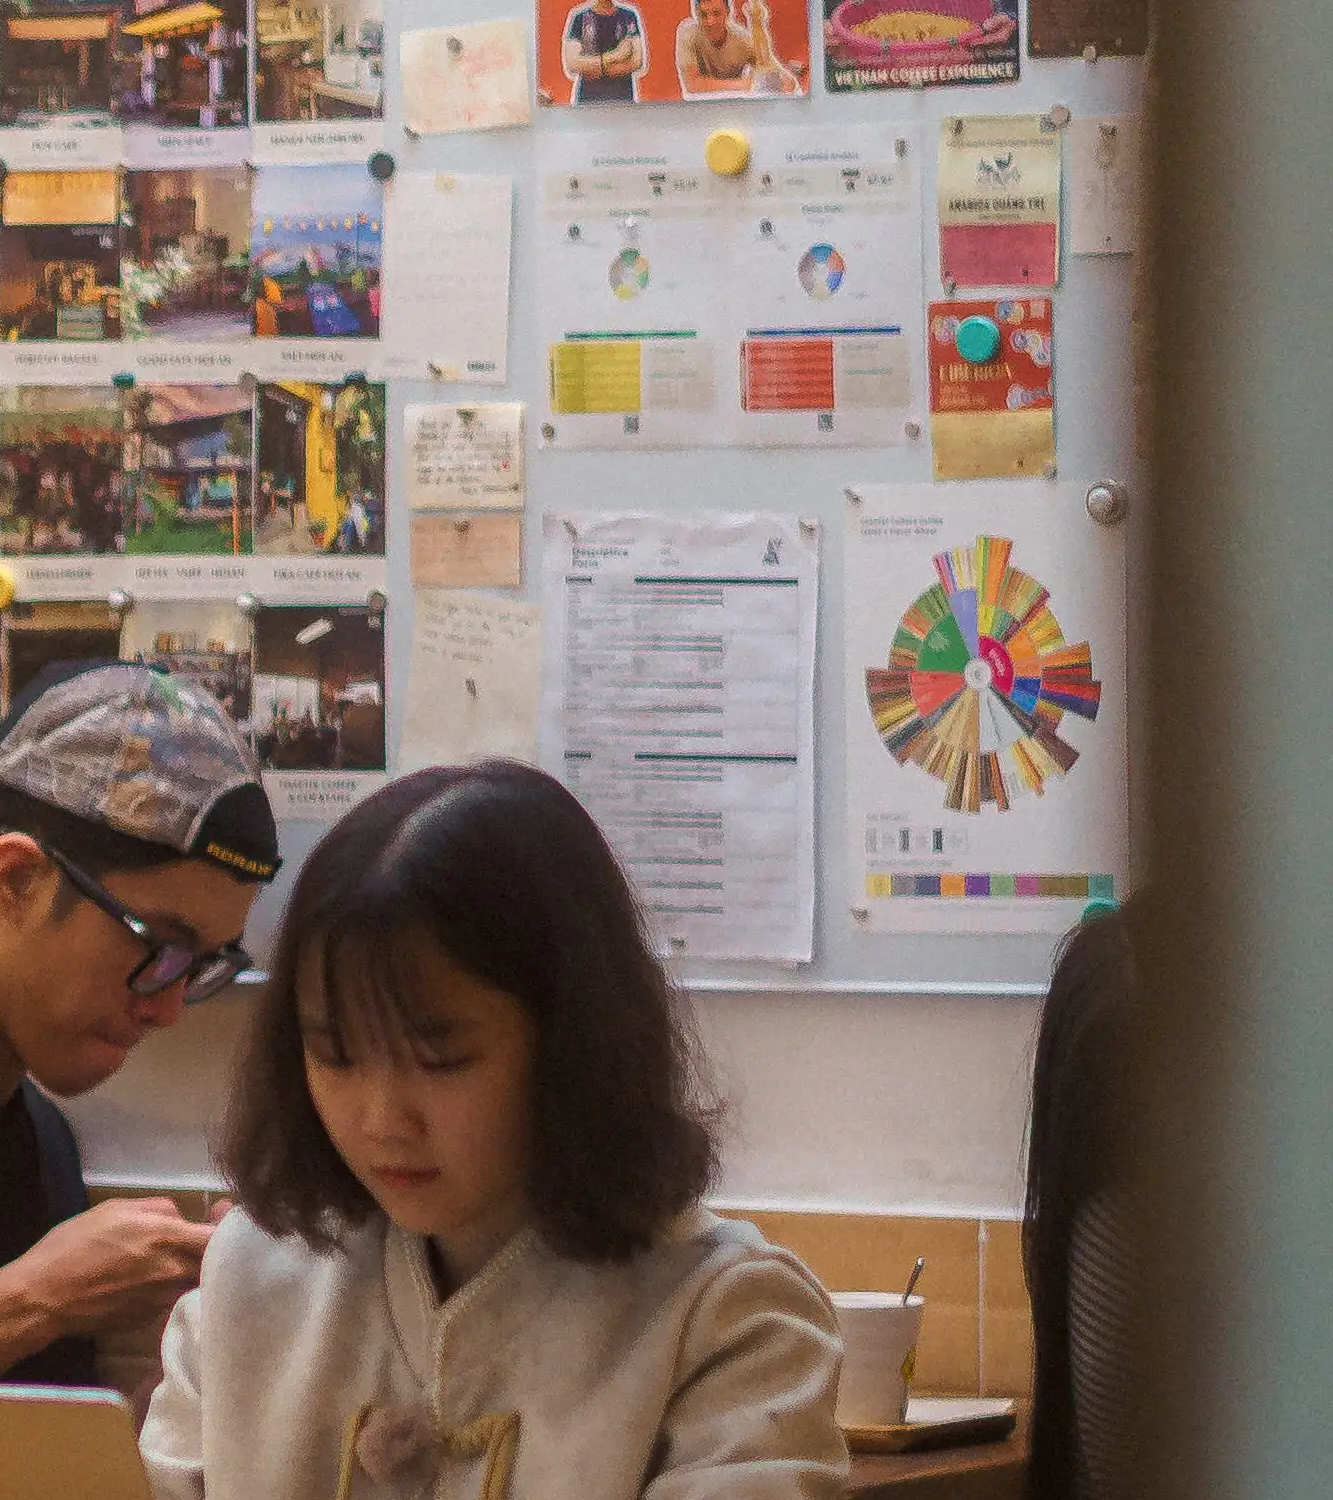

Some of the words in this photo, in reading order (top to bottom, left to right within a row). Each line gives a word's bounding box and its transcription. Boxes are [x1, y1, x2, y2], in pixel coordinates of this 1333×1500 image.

[835, 68, 889, 86] VIETNAM
[890, 65, 936, 82] COFFEE
[939, 62, 1014, 82] EXPERIENCE
